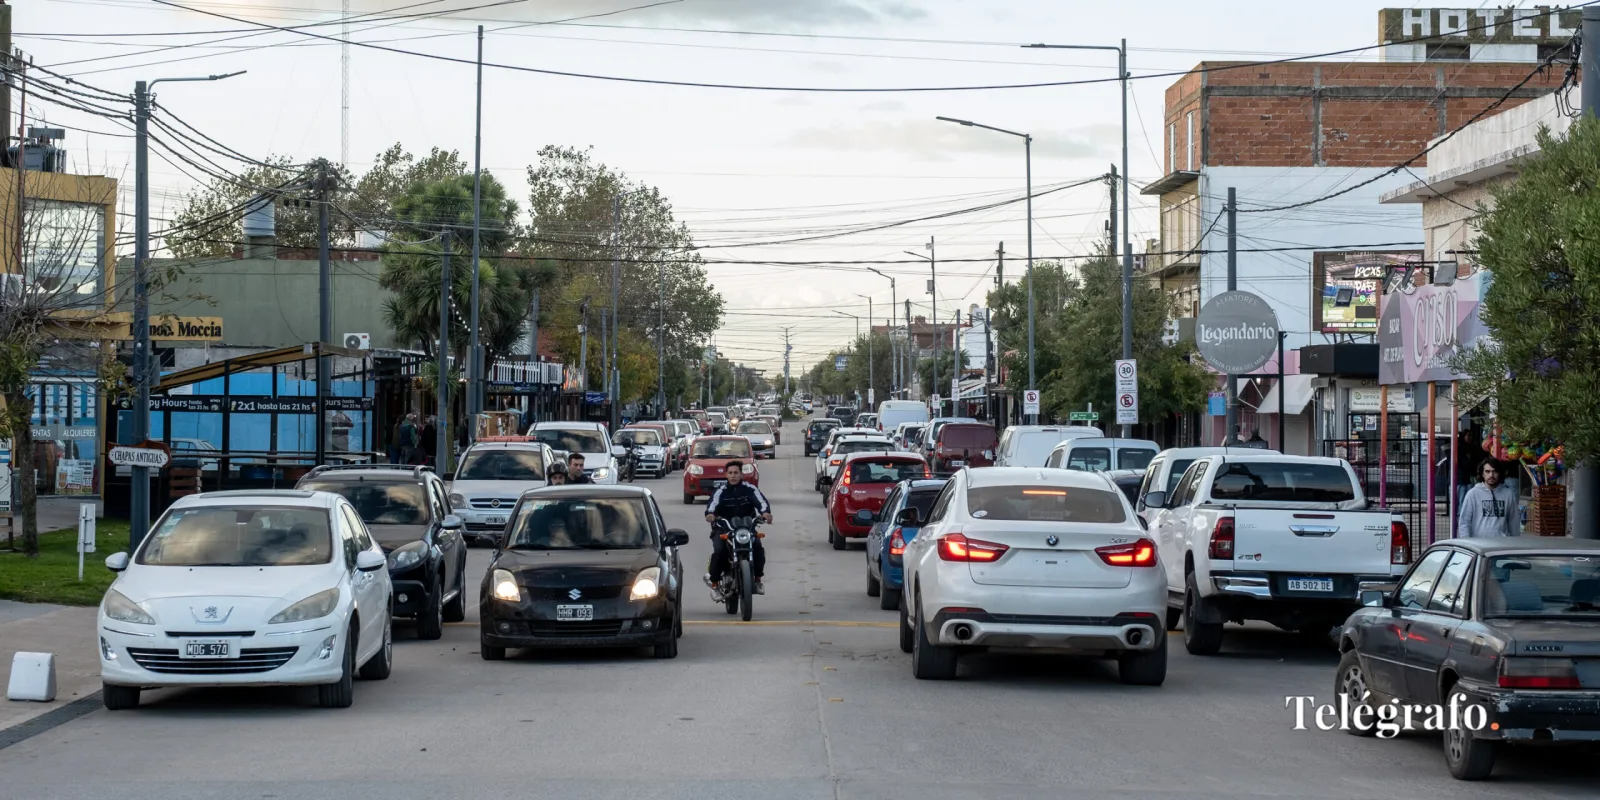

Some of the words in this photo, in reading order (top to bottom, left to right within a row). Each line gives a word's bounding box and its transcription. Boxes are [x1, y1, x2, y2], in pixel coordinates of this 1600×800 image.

[1402, 9, 1576, 37] HOTEL
[1215, 294, 1259, 307] ALFAJORES
[177, 321, 222, 337] Moccia
[1199, 322, 1275, 346] Legendario
[1209, 355, 1225, 369] SANTA
[1254, 354, 1266, 365] MAR
[1121, 366, 1131, 374] 30
[161, 398, 188, 408] Hours
[237, 401, 256, 411] 2x1
[257, 401, 278, 410] hasta
[279, 402, 291, 410] las
[291, 403, 301, 411] 21
[301, 402, 311, 411] hs
[32, 428, 51, 437] ENTAS
[62, 428, 96, 438] ALQUILERES
[114, 450, 135, 462] CHAPAS
[136, 451, 162, 464] ANTIGUAS
[1290, 581, 1301, 590] AB
[1303, 581, 1318, 590] 502
[1321, 581, 1331, 591] DE
[558, 608, 573, 618] HHR
[187, 644, 205, 655] MDG
[210, 644, 227, 655] 574
